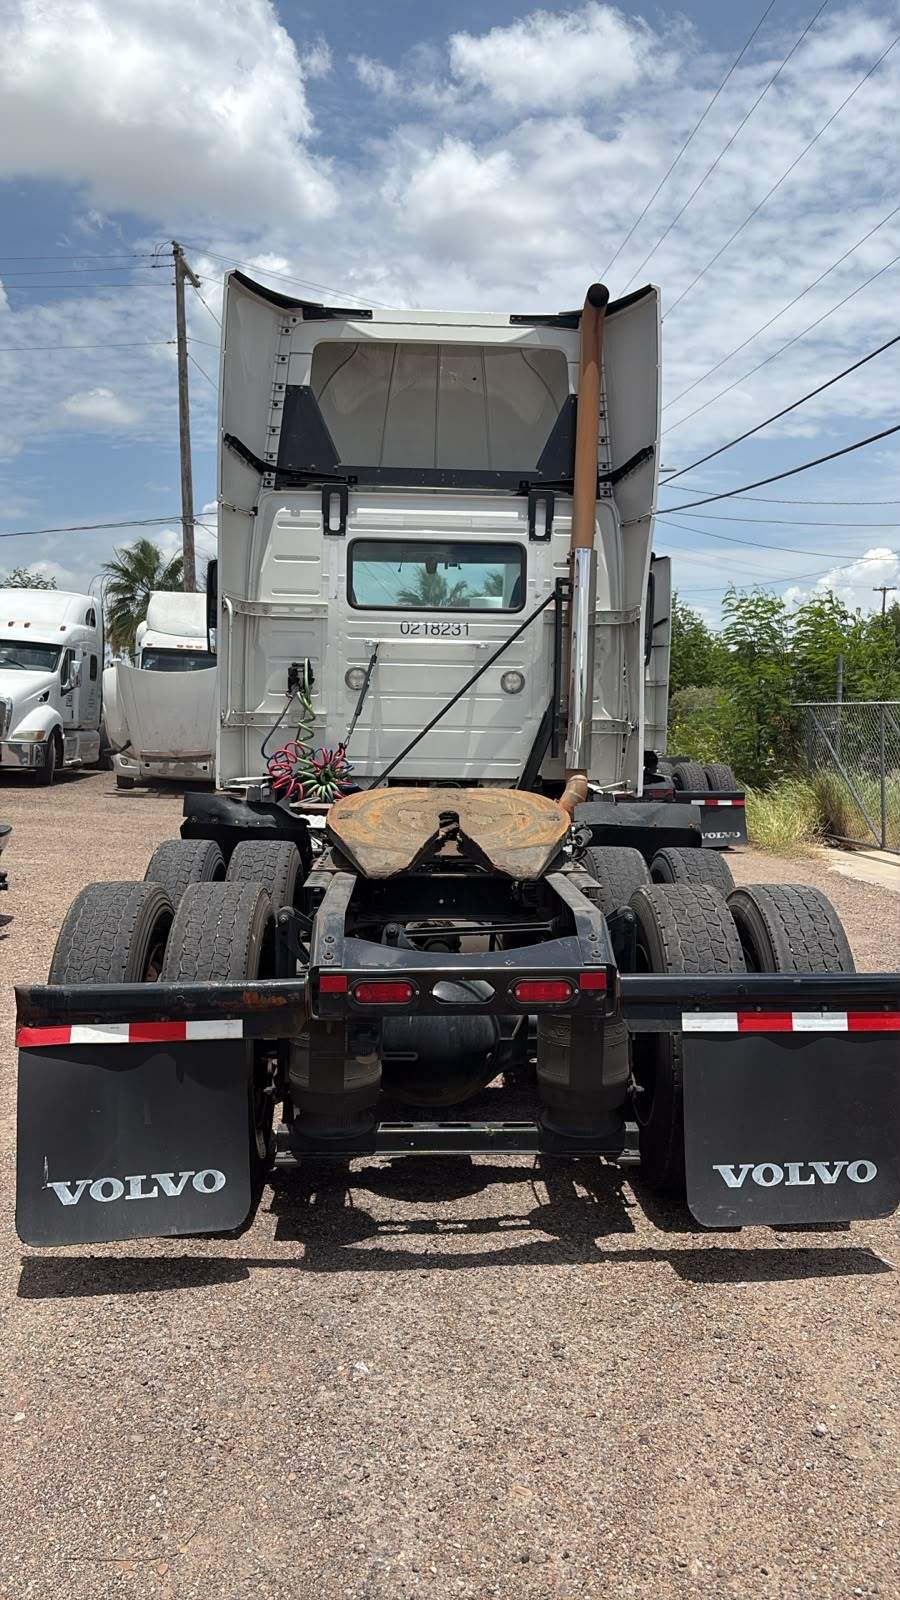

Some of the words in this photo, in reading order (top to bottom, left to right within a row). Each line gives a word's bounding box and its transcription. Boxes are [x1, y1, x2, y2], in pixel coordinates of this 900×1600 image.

[400, 621, 470, 636] 0218231
[701, 831, 741, 840] VOLVO
[712, 1159, 878, 1188] VOLVO
[46, 1169, 227, 1206] VOLVO
